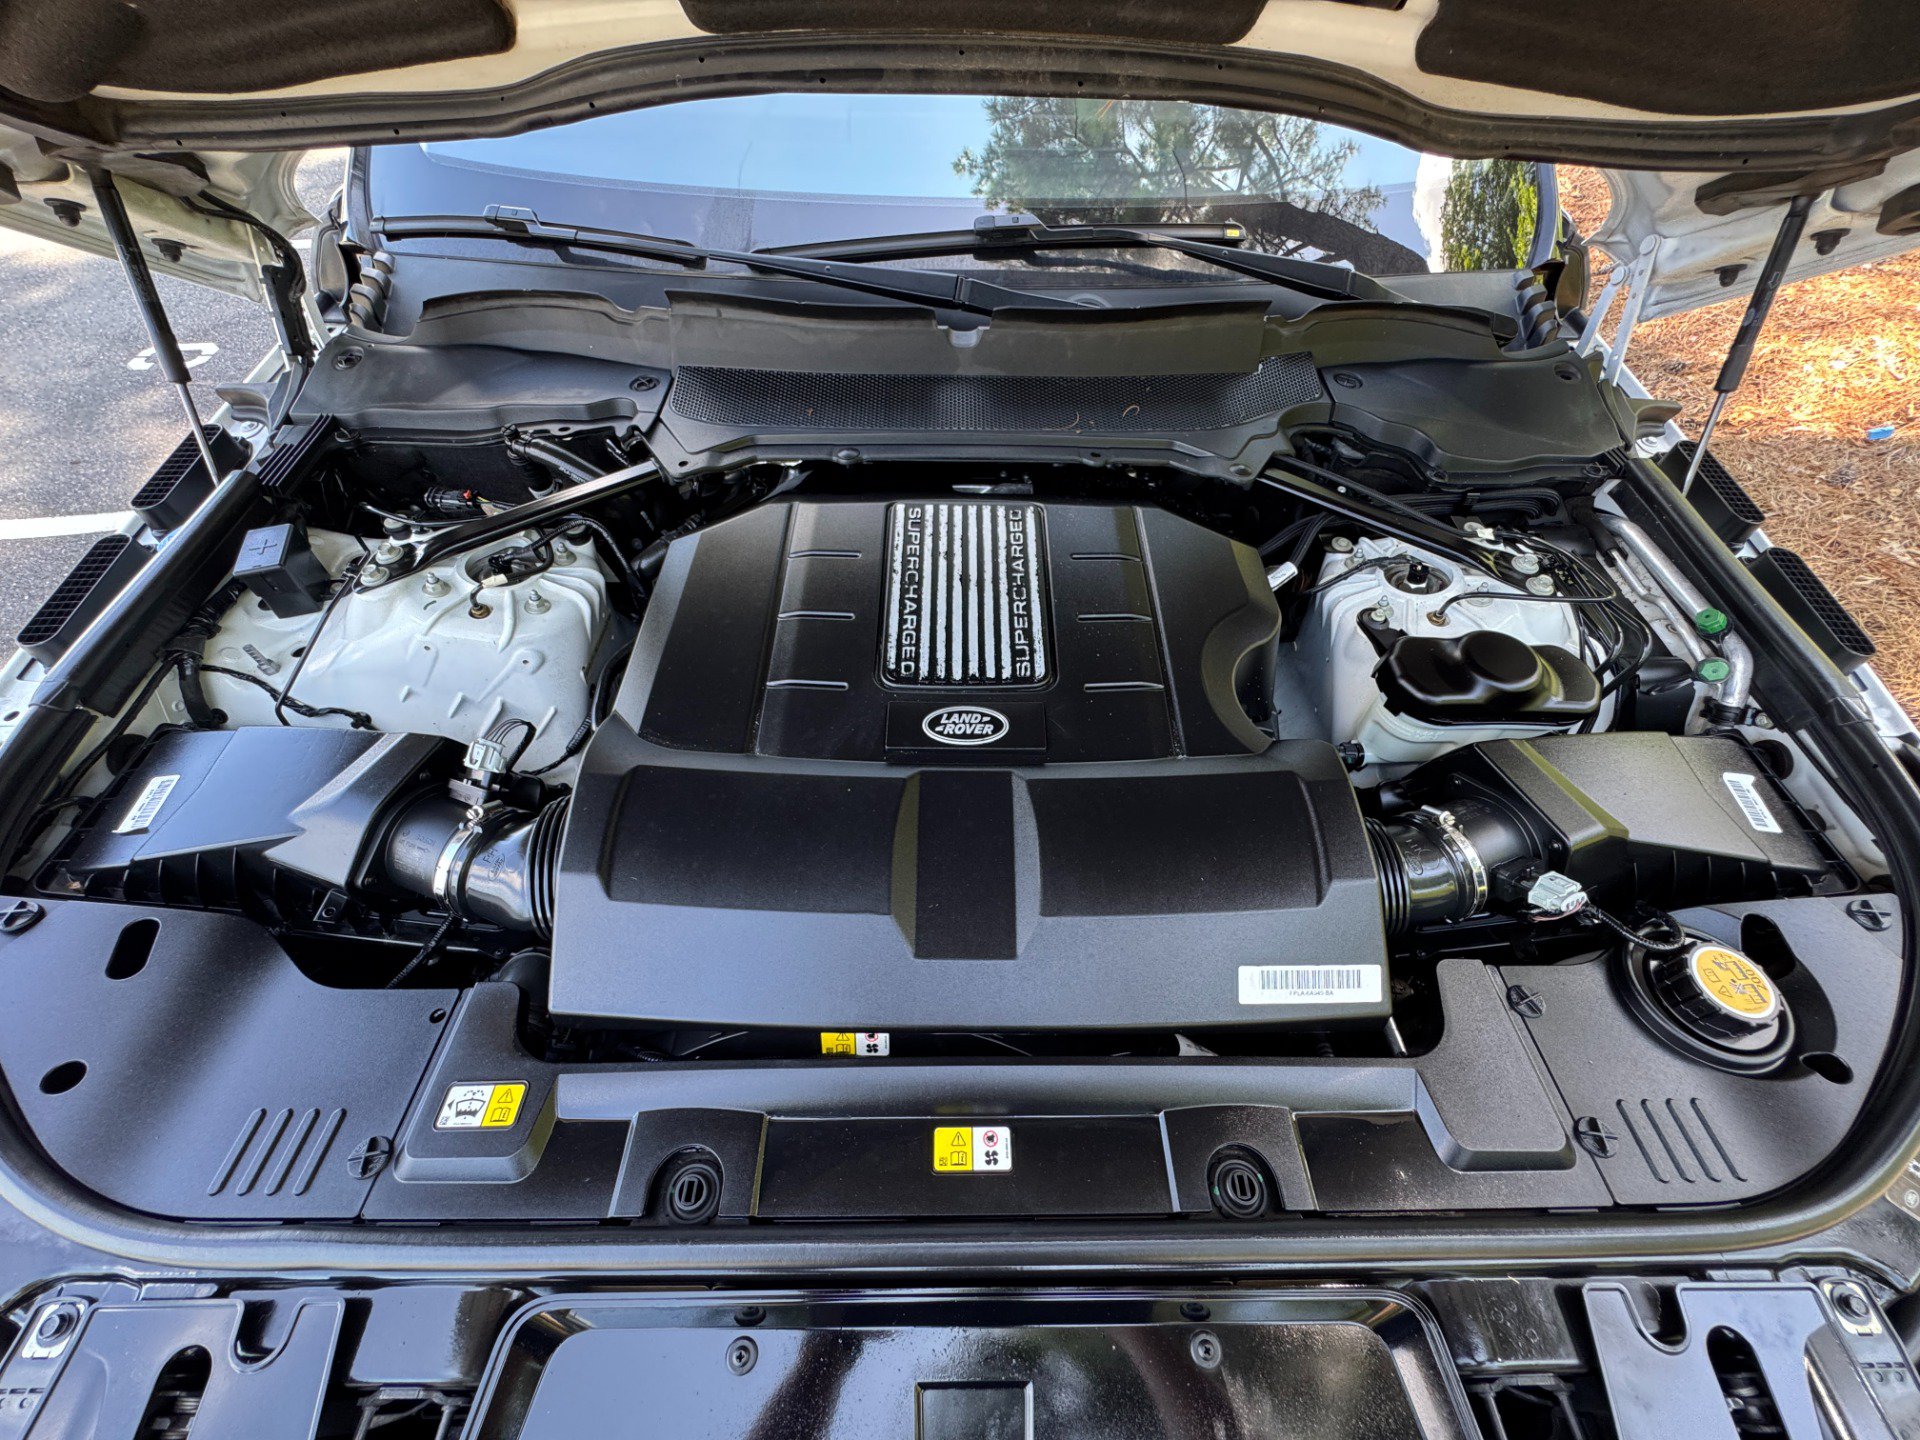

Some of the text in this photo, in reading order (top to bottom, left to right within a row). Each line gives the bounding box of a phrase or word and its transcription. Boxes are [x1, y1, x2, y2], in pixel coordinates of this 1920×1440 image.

[901, 507, 922, 677] SUPERCHARGED
[1009, 508, 1031, 678] SUPERCHARGED
[940, 713, 982, 724] LAND
[943, 724, 994, 735] ROVER
